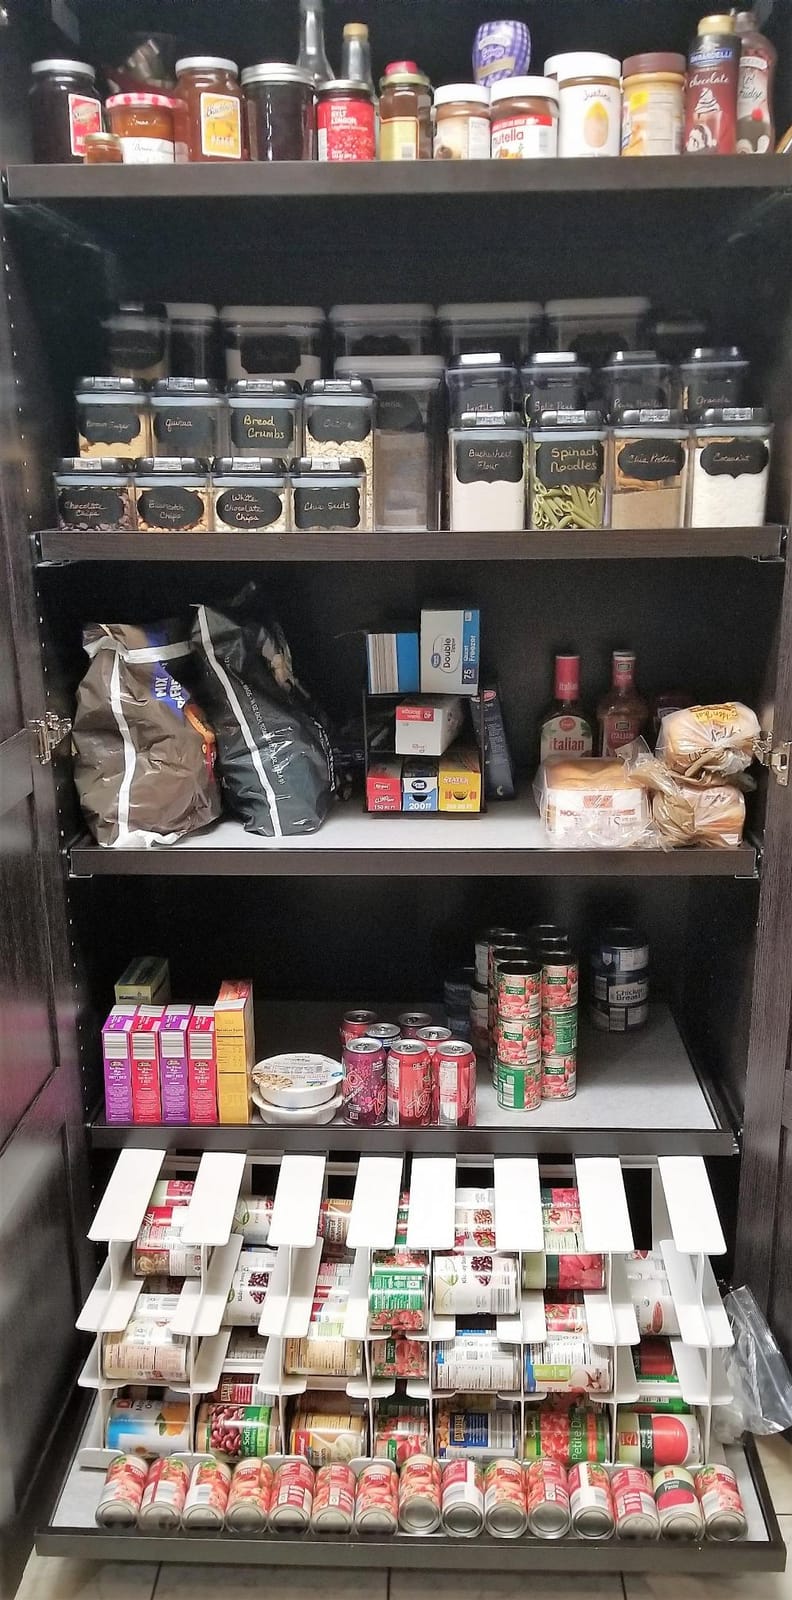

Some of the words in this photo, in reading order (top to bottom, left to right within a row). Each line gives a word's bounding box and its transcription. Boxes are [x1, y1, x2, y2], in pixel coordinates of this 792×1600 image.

[689, 71, 729, 88] chocolate
[492, 128, 525, 146] nutella
[243, 414, 275, 426] Bread
[247, 427, 286, 440] Crumbs
[551, 444, 599, 460] Spinach
[478, 461, 499, 471] Flour
[550, 459, 598, 473] Noodles
[231, 493, 258, 503] White
[64, 500, 107, 511] Chocolate
[224, 503, 264, 513] Chocolate
[327, 501, 351, 511] Seeds
[76, 509, 101, 519] Chips
[159, 511, 182, 523] Chips
[235, 512, 260, 524] Chips
[443, 637, 452, 669] Double
[469, 635, 477, 662] Freezer
[463, 668, 474, 680] 75
[155, 676, 169, 699] MIX
[572, 1428, 583, 1461] Petite
